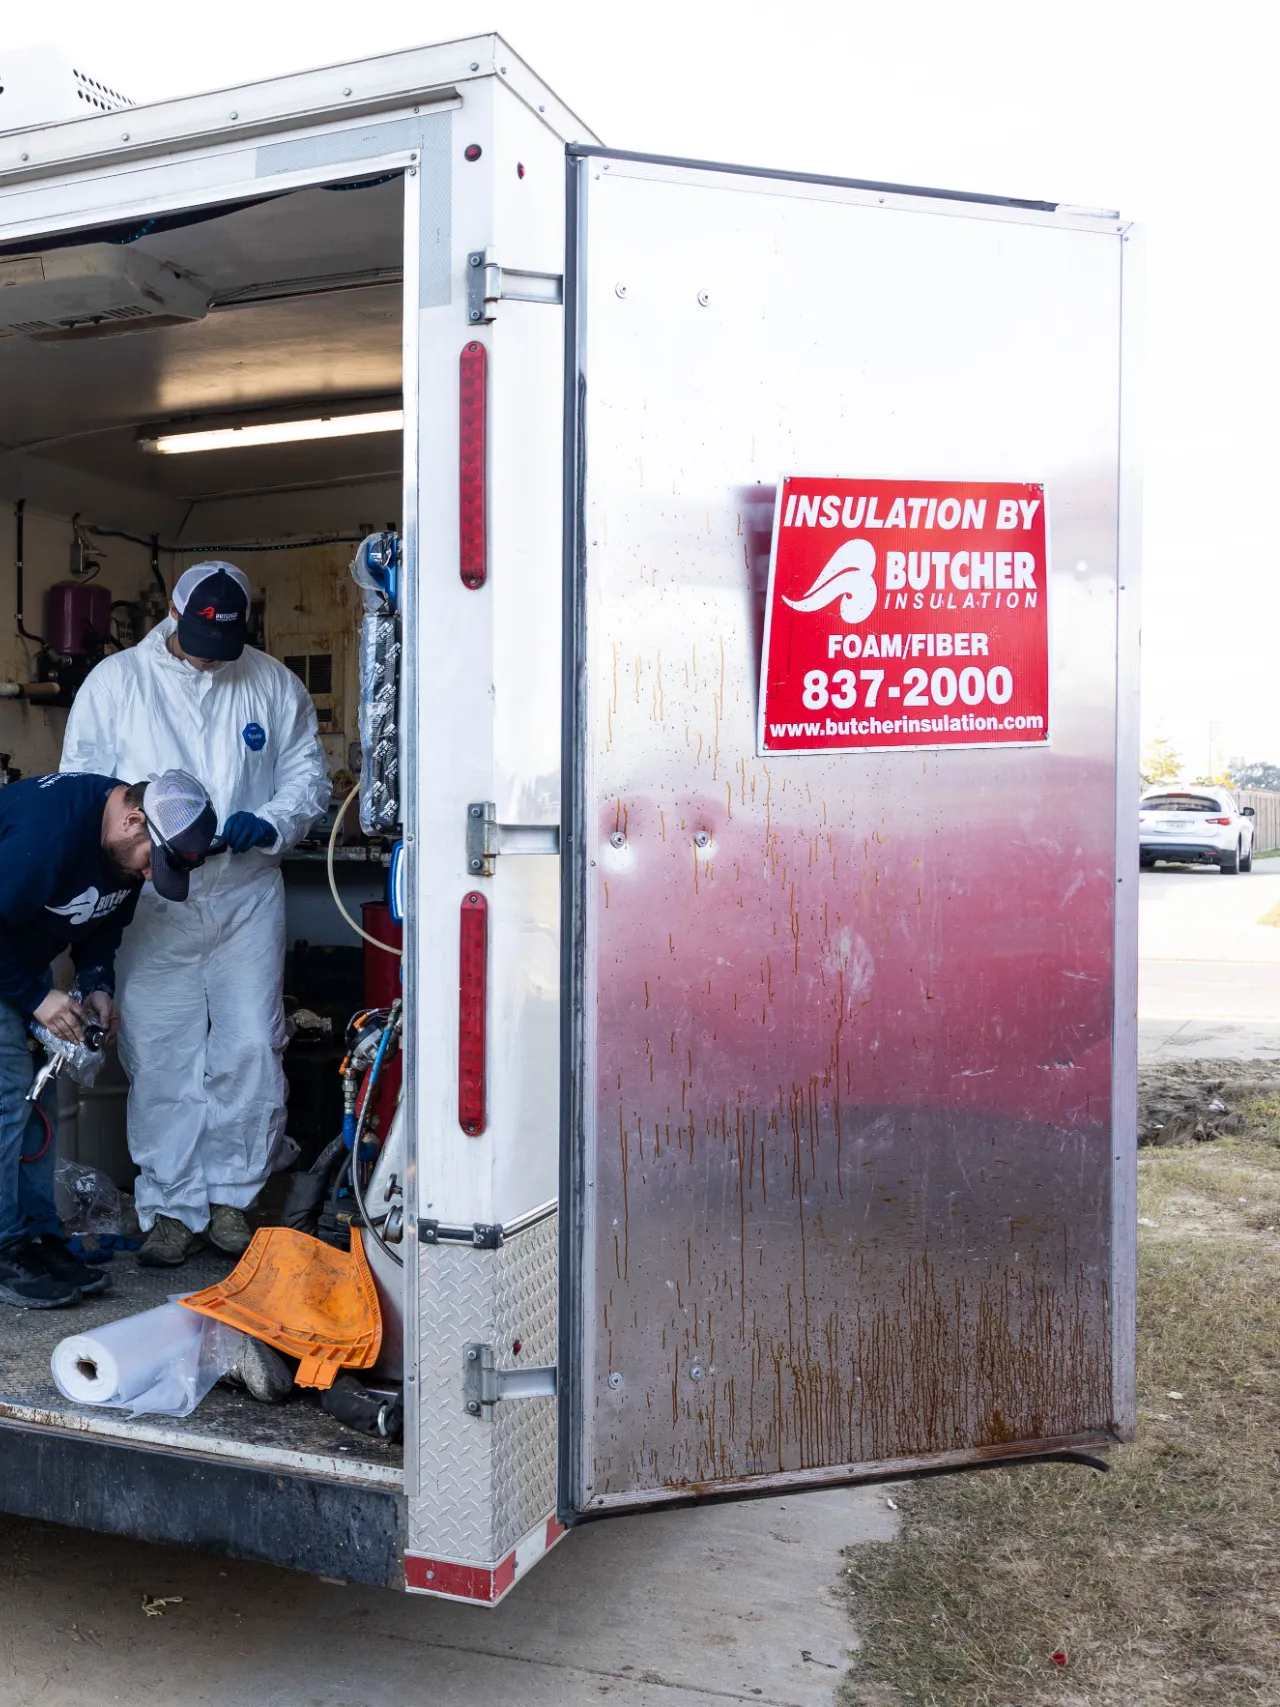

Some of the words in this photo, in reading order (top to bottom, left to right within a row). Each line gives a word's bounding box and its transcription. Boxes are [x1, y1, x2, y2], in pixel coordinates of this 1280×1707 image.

[783, 495, 987, 530] INSULATION
[996, 499, 1040, 530] BY
[885, 551, 1037, 590] BUTCHER
[884, 592, 1038, 610] INSULATION
[828, 632, 989, 660] FOAM/FIBER
[802, 666, 1013, 710] 837-2000
[770, 713, 1043, 737] www.butcherinsulation.com
